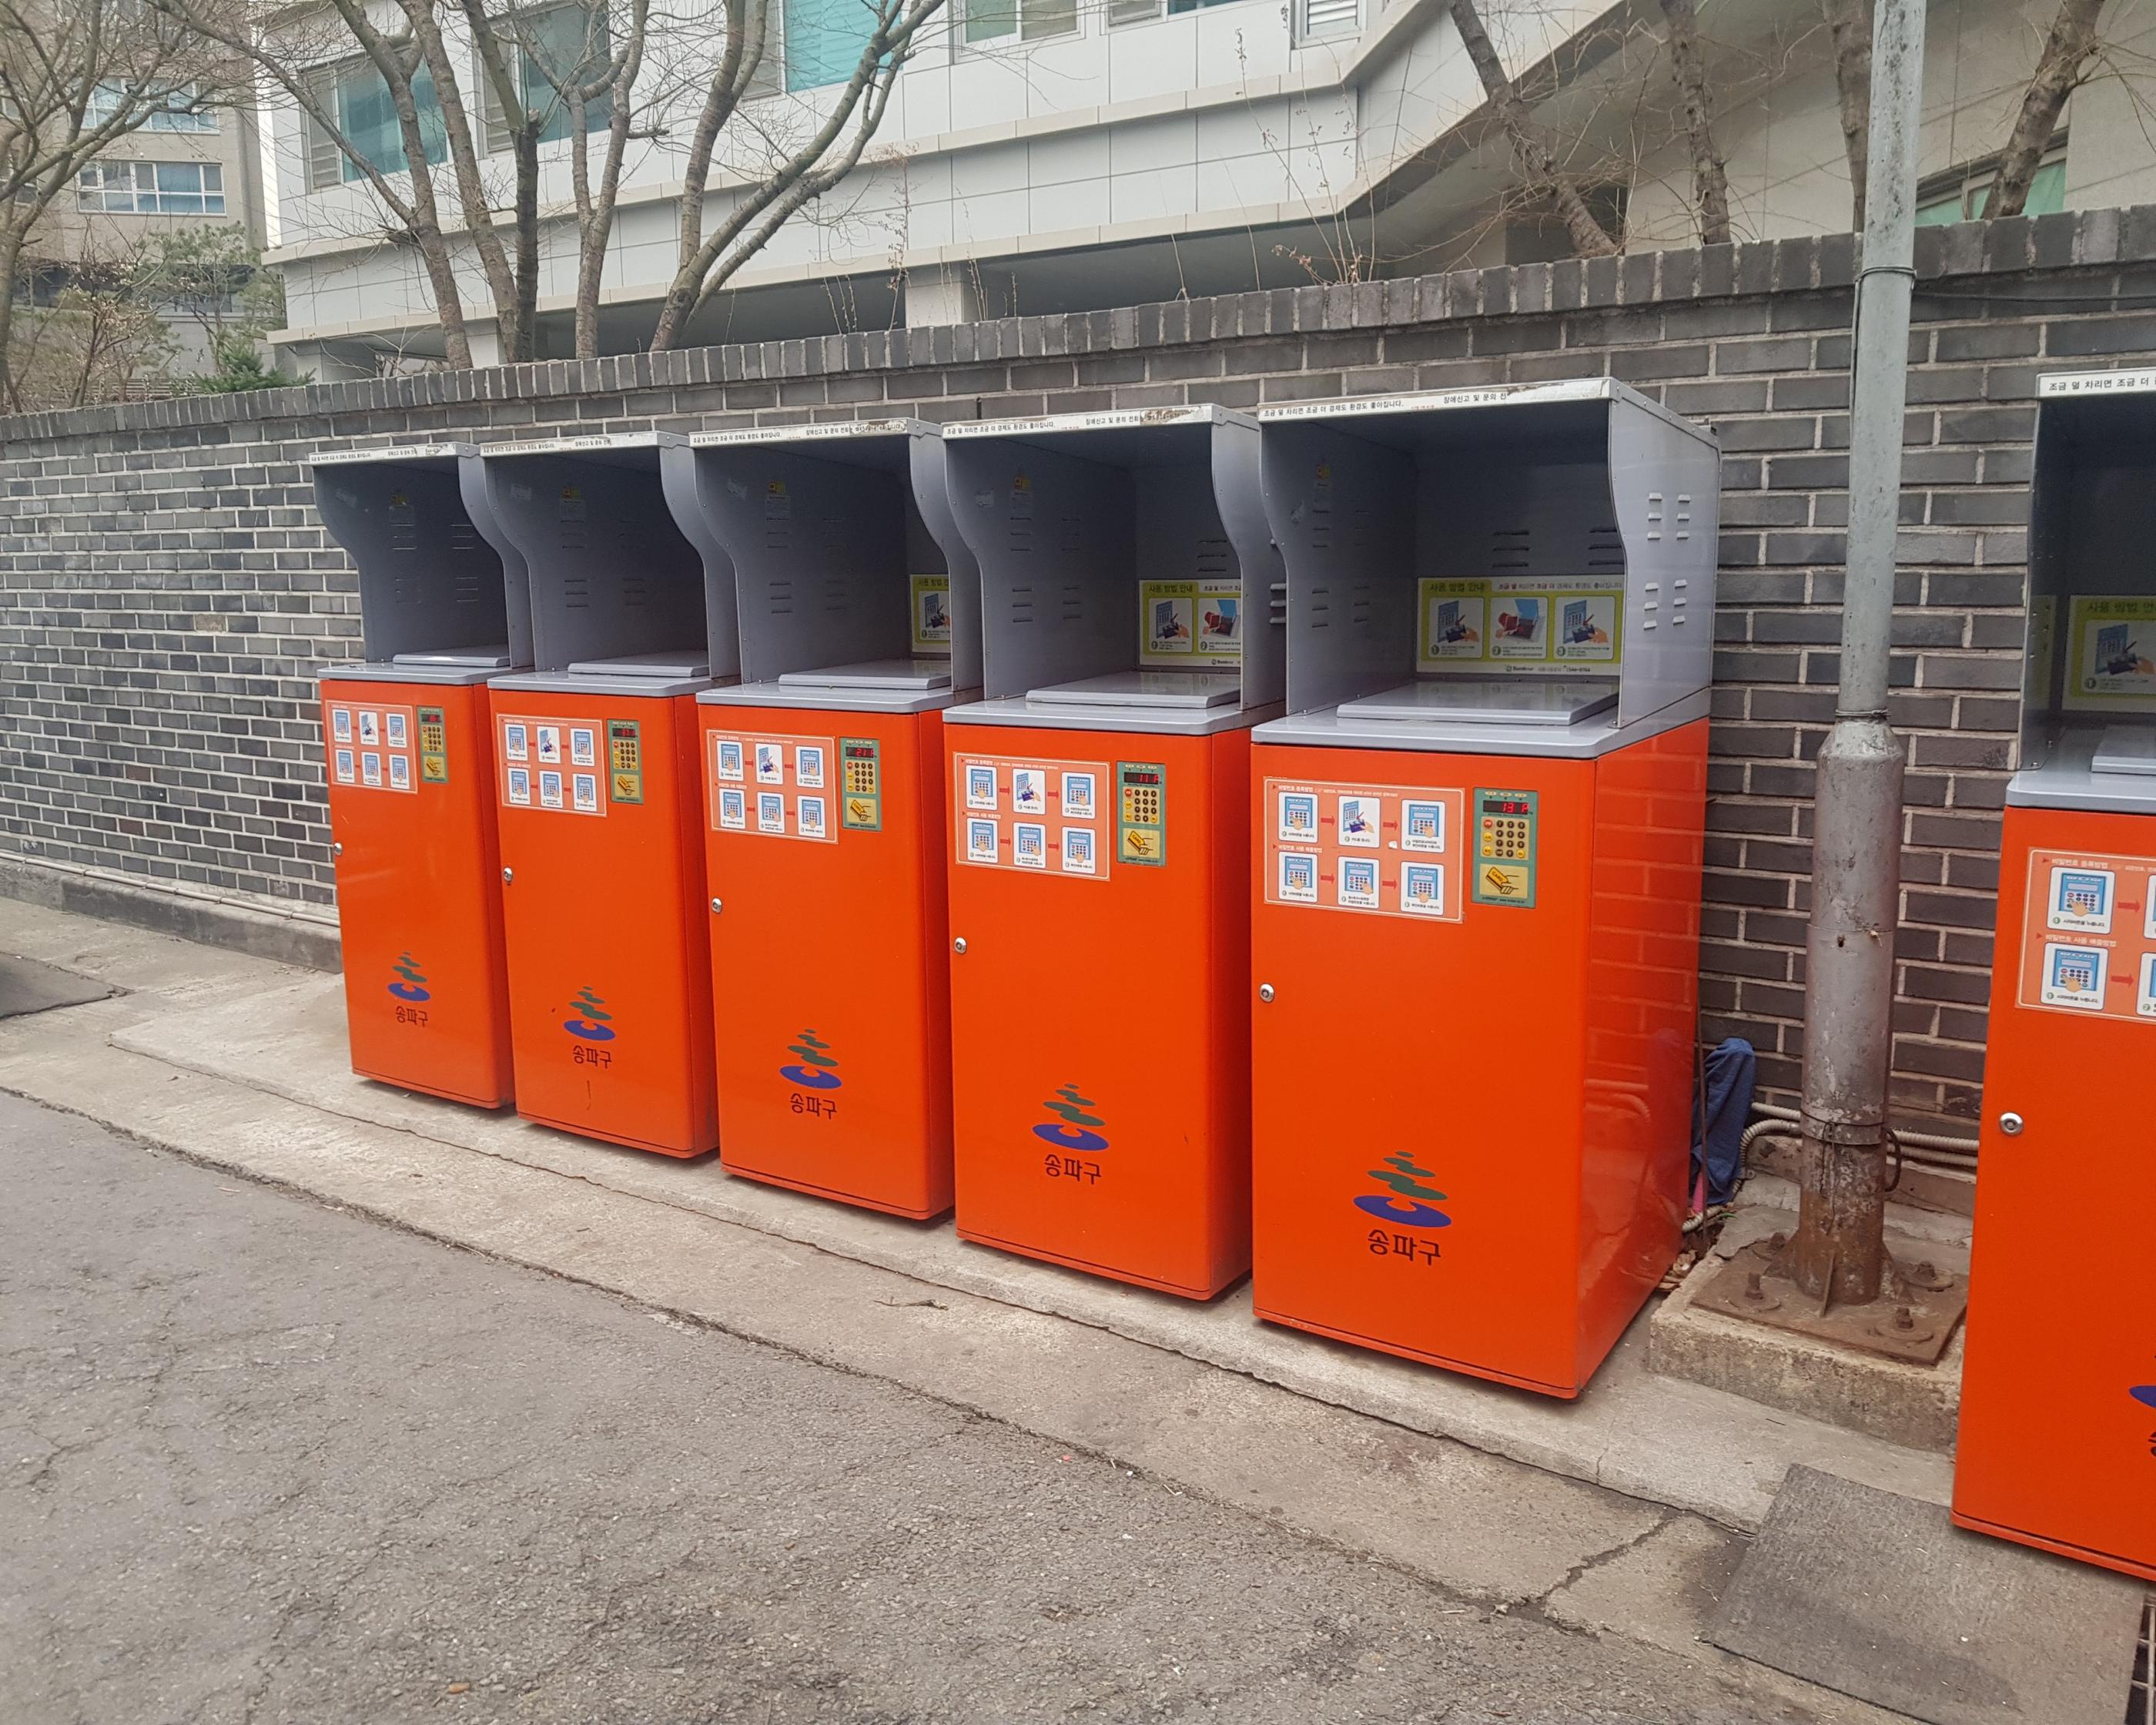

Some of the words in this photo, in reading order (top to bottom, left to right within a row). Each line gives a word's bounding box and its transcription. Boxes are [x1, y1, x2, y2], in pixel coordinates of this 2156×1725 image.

[2048, 382, 2067, 391] 조금
[2084, 379, 2112, 389] 차리면
[2116, 377, 2135, 387] 조금
[2141, 377, 2149, 386] 더
[1443, 394, 1469, 404] 장애신고
[1473, 394, 1479, 402] 및
[1483, 393, 1497, 401] 문의
[396, 1006, 428, 1027] 송파구
[573, 1045, 612, 1069] 송파구
[790, 1093, 837, 1120] 송파구
[1044, 1154, 1102, 1185] 송파구
[1368, 1229, 1441, 1266] 송파구
